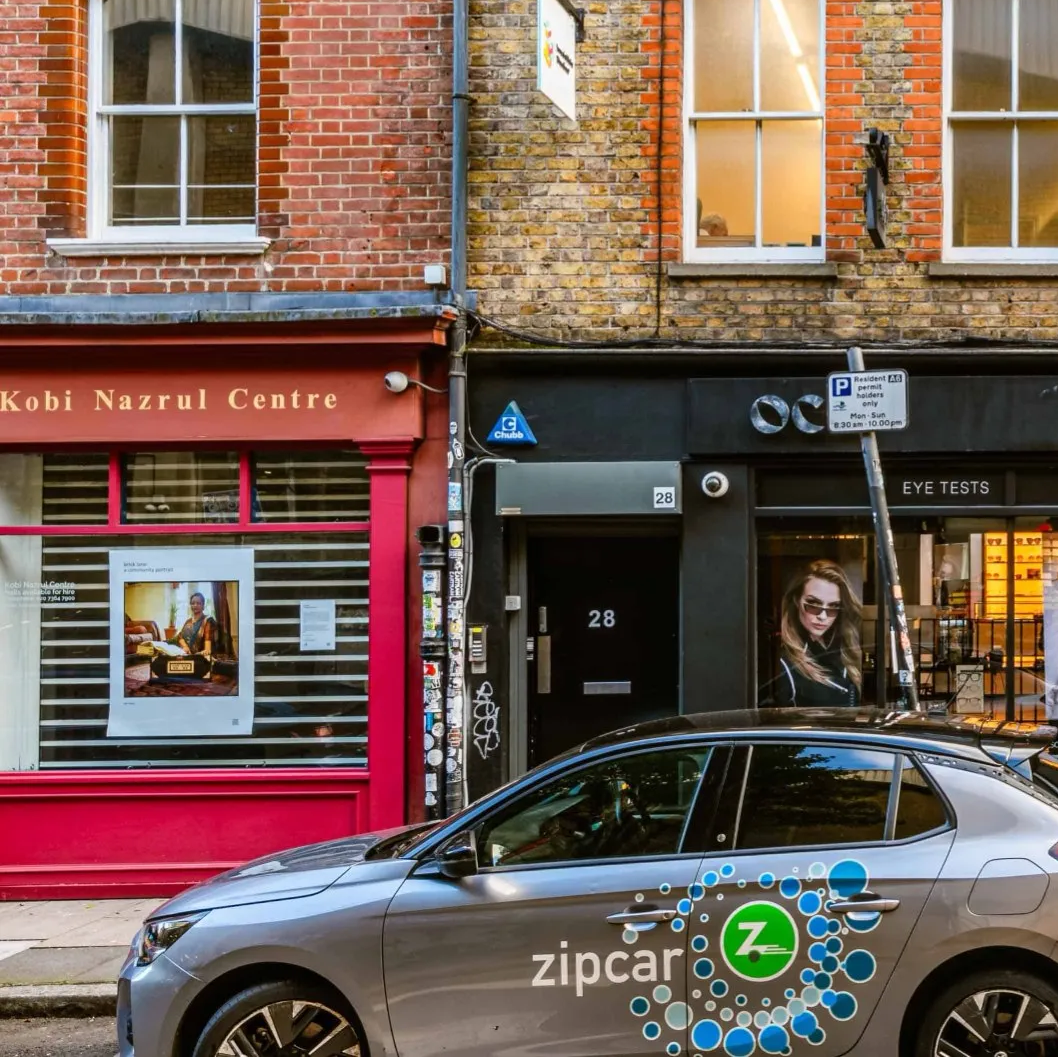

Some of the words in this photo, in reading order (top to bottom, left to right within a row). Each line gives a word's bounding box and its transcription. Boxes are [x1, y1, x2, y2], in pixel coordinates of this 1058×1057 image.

[835, 379, 849, 396] P
[0, 389, 72, 412] Kobi
[94, 388, 206, 411] Nazrul
[228, 387, 338, 410] Centre
[862, 400, 878, 408] only
[871, 411, 886, 419] Sun
[833, 421, 851, 429] 8.30
[494, 430, 524, 439] Chubb
[903, 481, 934, 495] EYE
[939, 481, 990, 495] TESTS
[655, 492, 673, 505] 28
[587, 610, 616, 628] 28
[531, 940, 684, 997] zipcar
